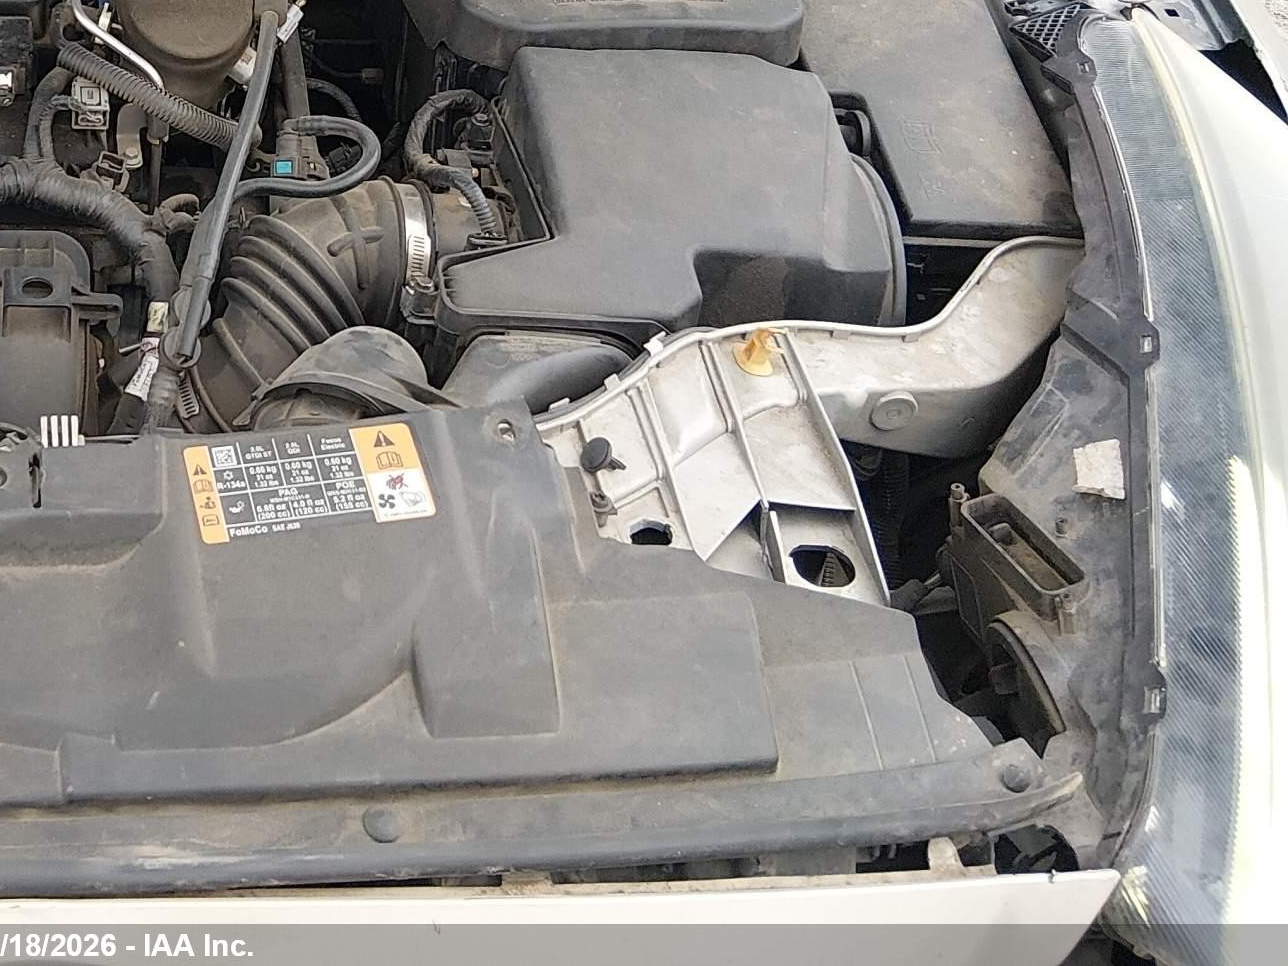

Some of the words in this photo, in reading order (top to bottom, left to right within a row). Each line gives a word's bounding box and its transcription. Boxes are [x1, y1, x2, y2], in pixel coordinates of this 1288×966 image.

[301, 460, 313, 470] kg
[341, 456, 352, 466] kg
[266, 465, 277, 474] kg
[216, 480, 246, 490] R-134a
[278, 488, 298, 497] PAG
[295, 507, 314, 517] (120
[315, 505, 328, 515] cc)
[229, 526, 269, 539] FoMoCo
